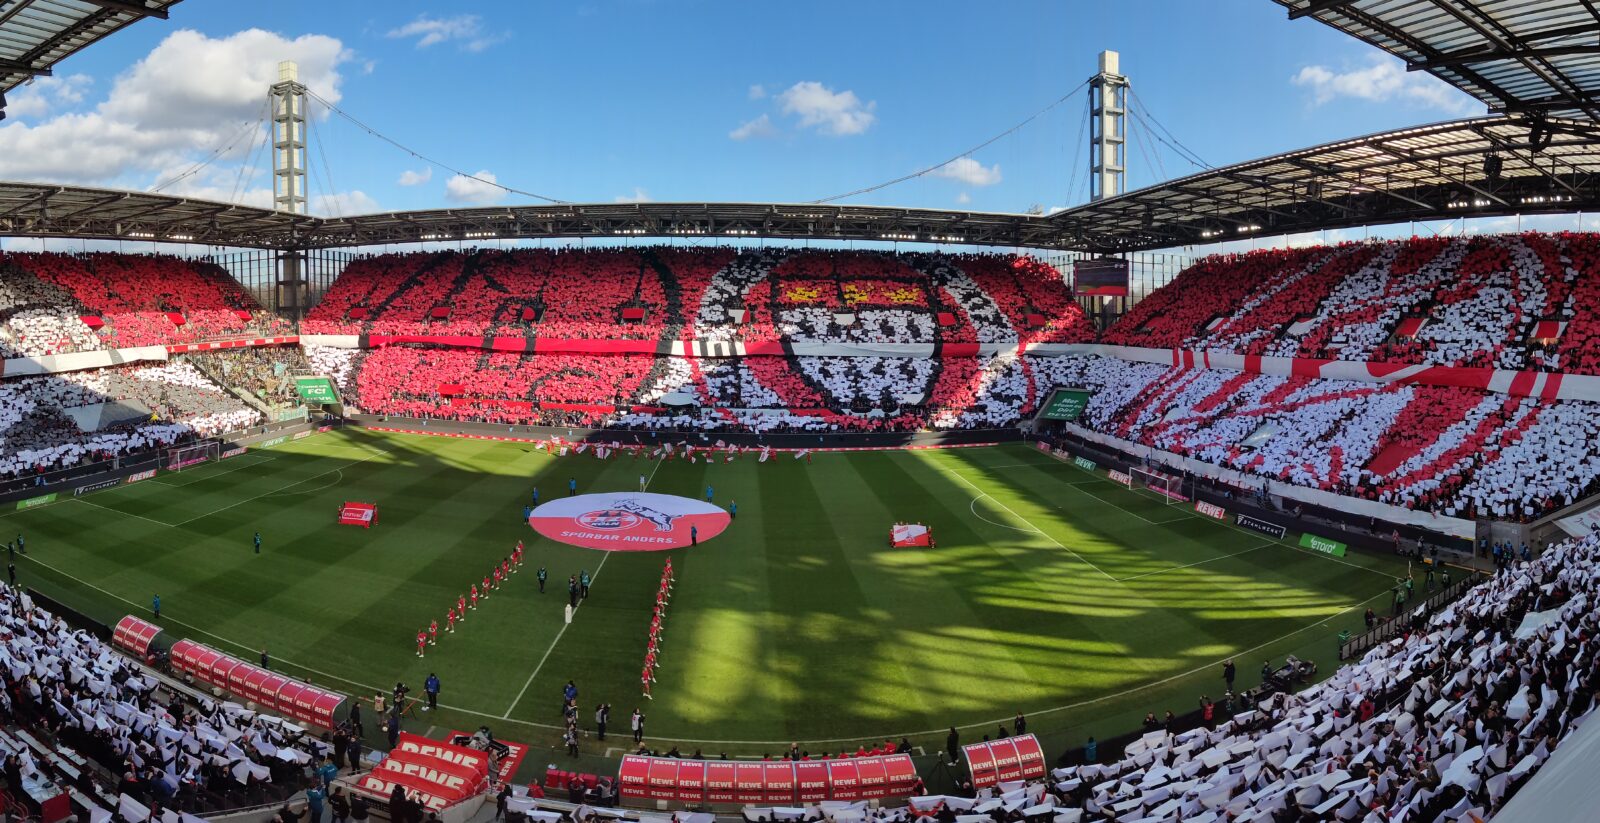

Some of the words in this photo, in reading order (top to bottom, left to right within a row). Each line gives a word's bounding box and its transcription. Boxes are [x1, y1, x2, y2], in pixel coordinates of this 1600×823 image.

[1075, 456, 1093, 470] DEVK
[132, 470, 156, 482] REWE
[1109, 469, 1130, 485] REWE
[1196, 501, 1222, 518] REWE
[560, 531, 619, 541] SPÜRBAR
[624, 535, 677, 544] ANDERS.
[973, 761, 994, 770] REWE
[997, 756, 1018, 765] REWE
[1021, 751, 1041, 761] REWE
[622, 775, 644, 783] REWE
[651, 777, 674, 786] REWE
[679, 779, 701, 787] REWE
[834, 778, 857, 786] REWE
[862, 776, 884, 784] REWE
[890, 774, 913, 782] REWE
[975, 775, 996, 784] REWE
[1000, 770, 1020, 780] REWE
[1024, 765, 1044, 775] REWE
[651, 790, 674, 798] REWE
[890, 786, 914, 794] REWE
